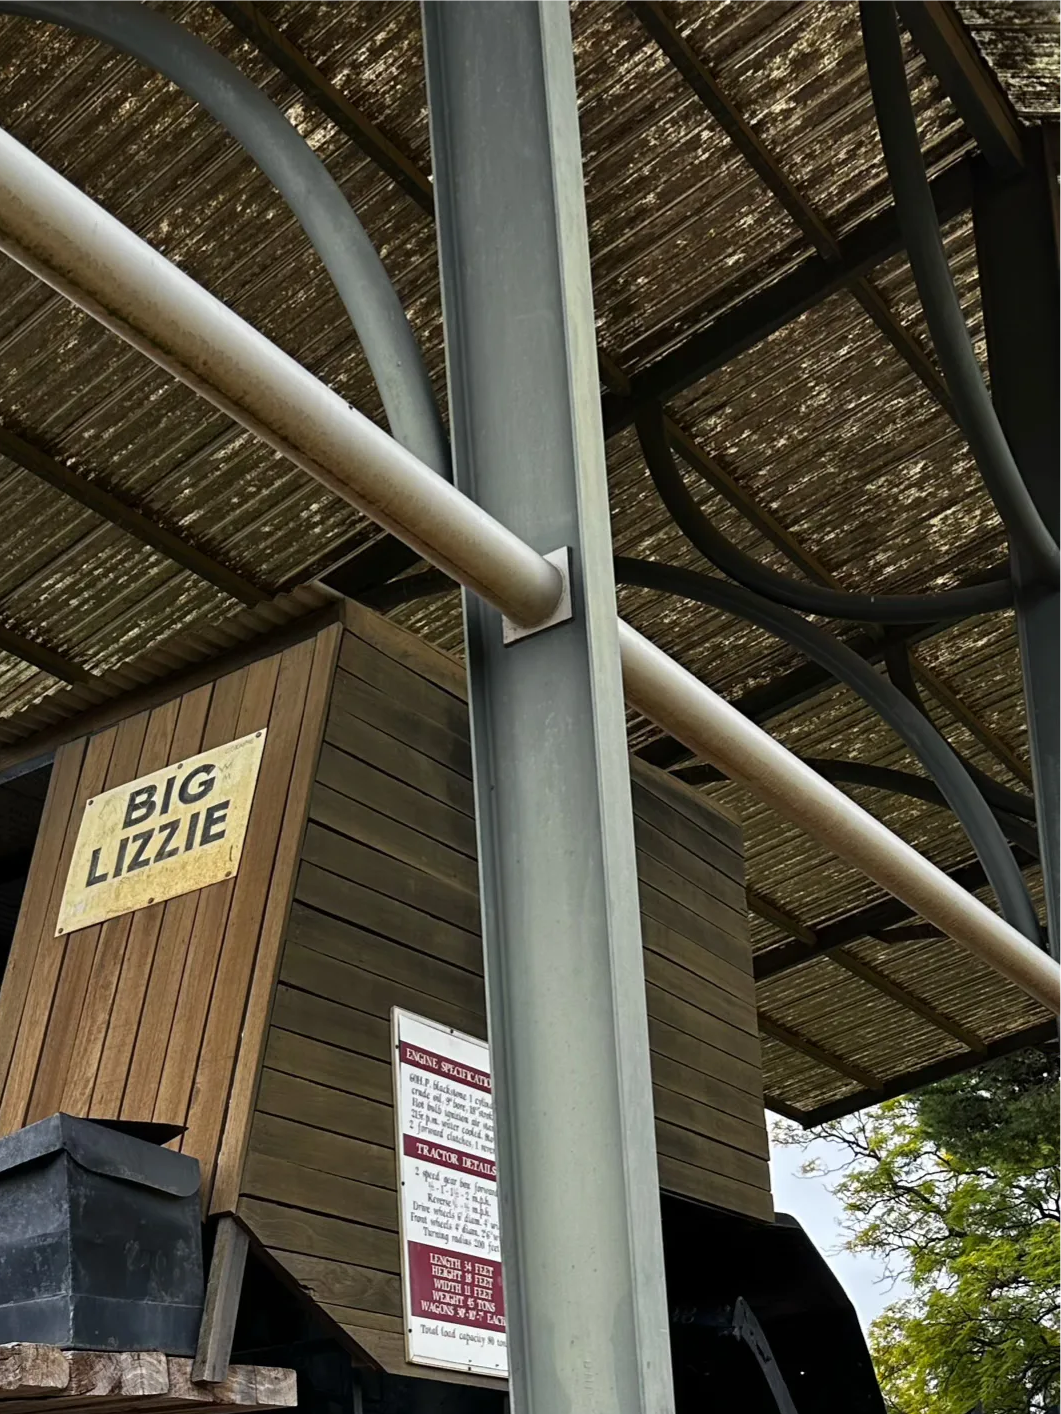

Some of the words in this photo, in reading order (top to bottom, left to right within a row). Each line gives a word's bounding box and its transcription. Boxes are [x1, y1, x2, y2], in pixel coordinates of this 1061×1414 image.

[121, 763, 216, 830] BIG
[85, 799, 231, 888] LIZZIE
[406, 1048, 438, 1069] ENGINE
[441, 1061, 491, 1088] SPECIFICATIO
[412, 1084, 430, 1099] crude
[412, 1097, 424, 1108] Hot
[427, 1102, 441, 1114] bulb
[445, 1108, 468, 1127] ignition
[409, 1120, 413, 1128] 2
[417, 1122, 443, 1141] forward
[442, 1120, 459, 1131] water
[416, 1143, 458, 1164] TRACTOR
[462, 1157, 496, 1176] DETAILS
[415, 1167, 419, 1175] 2
[423, 1167, 440, 1185] speed
[444, 1176, 457, 1189] gear
[460, 1178, 470, 1189] box
[413, 1200, 429, 1213] Drive
[433, 1205, 454, 1218] wheels
[428, 1193, 451, 1206] Reverse
[411, 1212, 427, 1224] Front
[430, 1216, 451, 1229] wheels
[423, 1226, 449, 1244] Turning
[452, 1232, 471, 1245] radius
[474, 1239, 484, 1248] 200
[430, 1253, 461, 1269] LENGTH
[464, 1262, 471, 1271] 34
[475, 1264, 494, 1276] FEET
[432, 1266, 462, 1280] HEIGHT
[465, 1273, 471, 1282] 18
[475, 1275, 493, 1287] FEET
[434, 1278, 461, 1292] WIDTH
[464, 1286, 470, 1294] 11
[474, 1287, 493, 1299] FEET
[421, 1300, 454, 1316] WAGONS
[487, 1314, 505, 1325] EACH
[432, 1291, 464, 1305] WEIGHT
[467, 1298, 474, 1307] 45
[477, 1300, 495, 1312] TONS
[420, 1324, 438, 1335] Total
[441, 1326, 456, 1338] load
[459, 1330, 485, 1347] capacity
